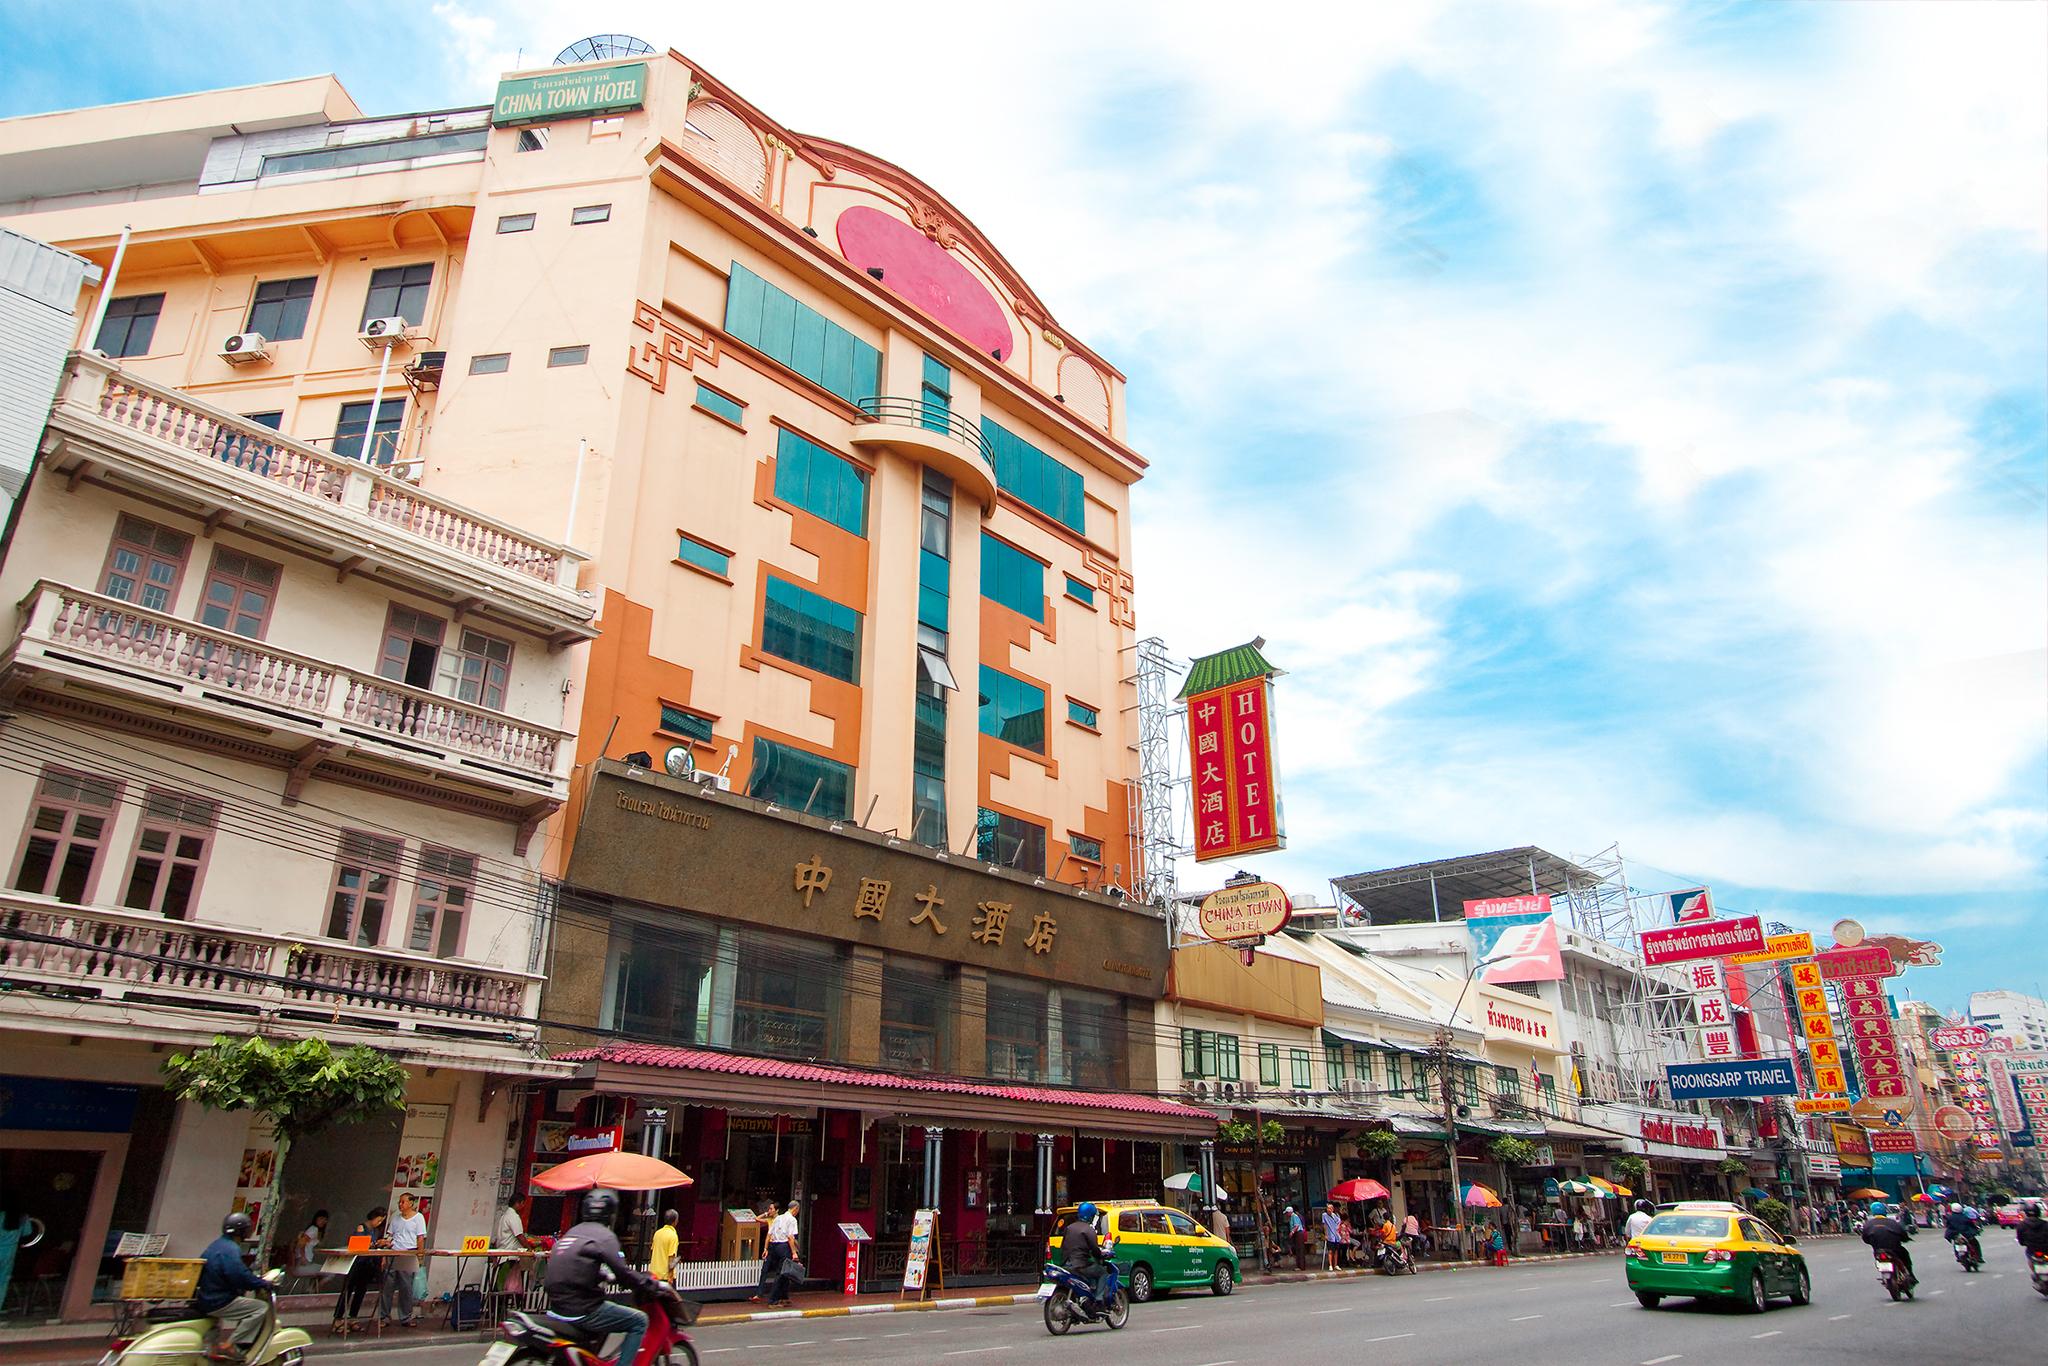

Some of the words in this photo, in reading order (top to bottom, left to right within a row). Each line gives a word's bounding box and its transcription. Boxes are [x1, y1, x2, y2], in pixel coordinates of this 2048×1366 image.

[499, 91, 543, 116] CHINA
[547, 86, 590, 109] TOWN
[594, 80, 638, 103] HOTEL
[1197, 702, 1226, 847] 中國大酒店
[1237, 690, 1263, 839] HOTEL
[616, 789, 656, 816] โรงแรม
[793, 854, 1058, 955] 中國大酒店
[1205, 904, 1243, 923] CHINA
[1246, 897, 1283, 917] TOWN
[1225, 920, 1262, 933] HOTEL
[1691, 965, 1732, 1057] 振成豐
[1671, 1071, 1742, 1090] ROONGSARP
[1744, 1067, 1791, 1086] TRAVEL
[467, 1239, 485, 1250] 100
